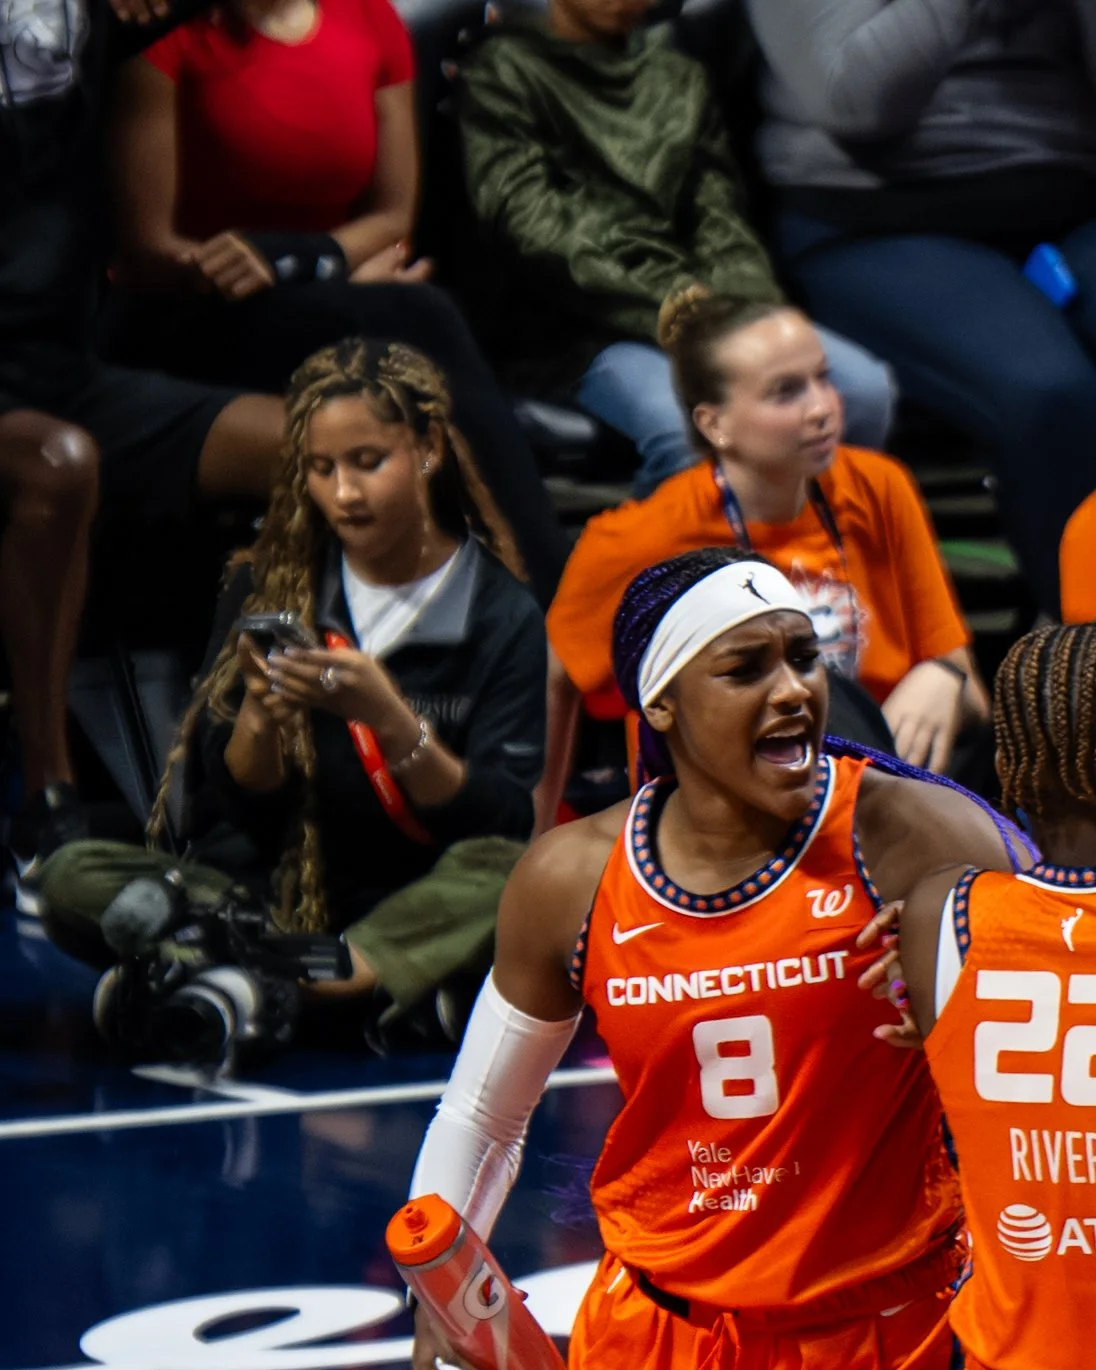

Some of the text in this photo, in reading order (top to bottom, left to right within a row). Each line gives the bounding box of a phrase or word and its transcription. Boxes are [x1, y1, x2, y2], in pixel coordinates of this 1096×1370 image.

[606, 950, 849, 1007] CONNECTICUT
[692, 1014, 779, 1120] 8
[687, 1139, 732, 1163] Yale
[687, 1188, 758, 1214] Health
